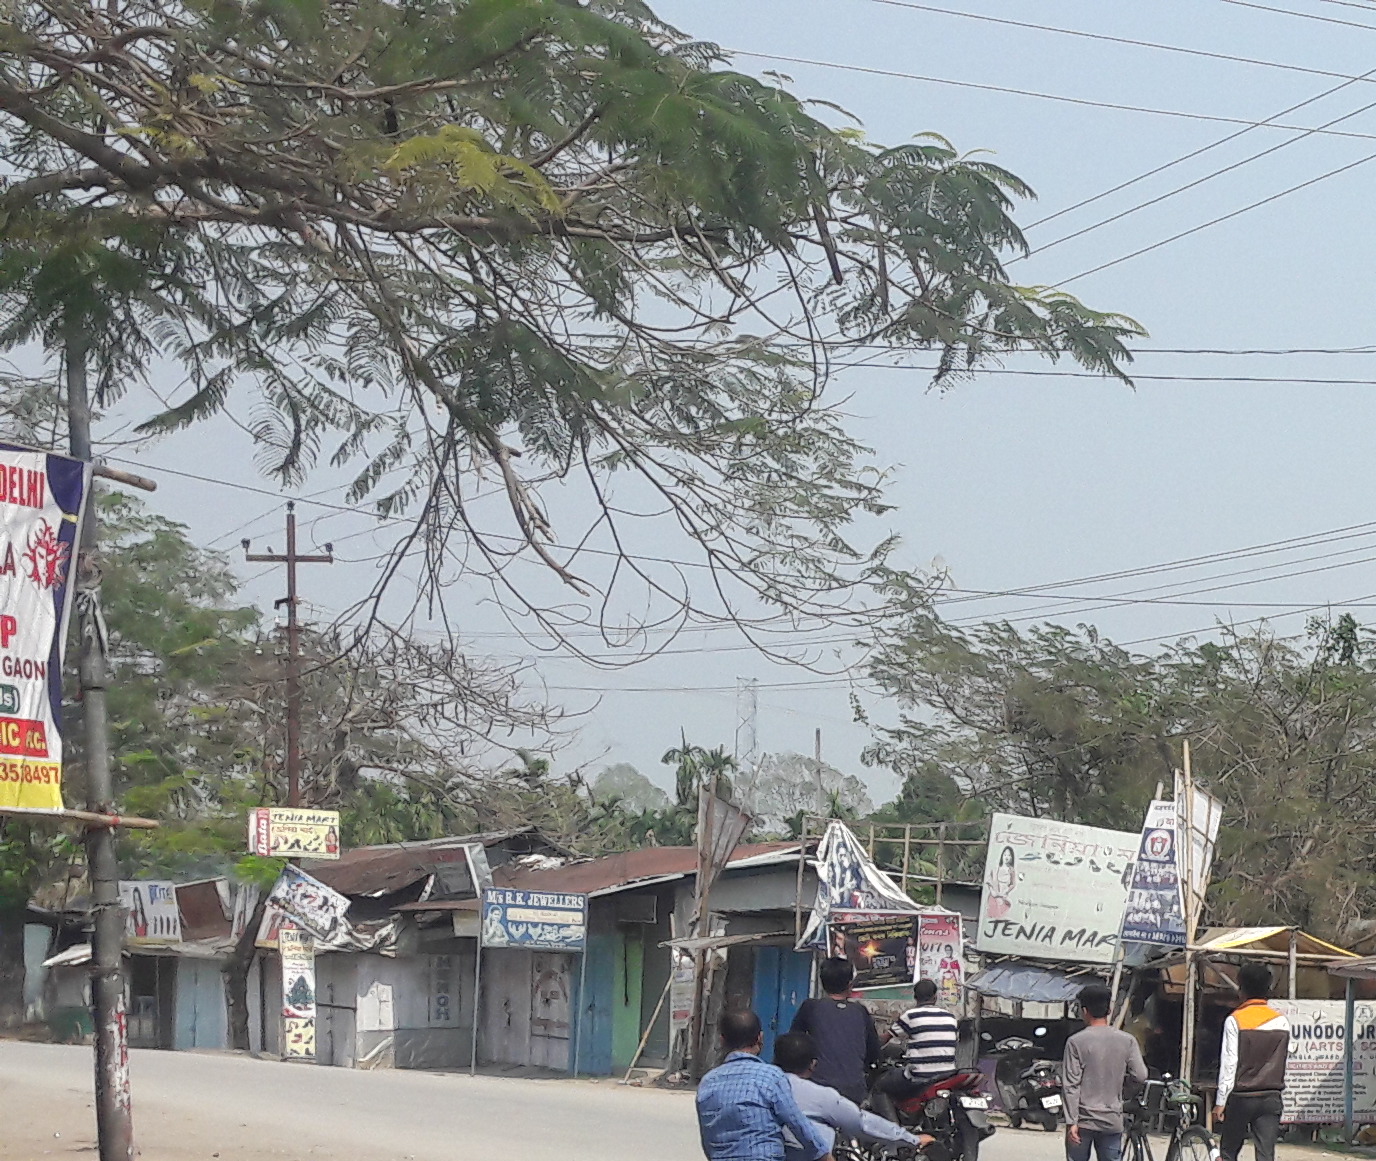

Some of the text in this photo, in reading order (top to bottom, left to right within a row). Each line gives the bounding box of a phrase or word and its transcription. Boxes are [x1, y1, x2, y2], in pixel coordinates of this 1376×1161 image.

[0, 541, 16, 578] A
[3, 656, 45, 680] GAON
[528, 894, 584, 909] JEWELLERS
[984, 920, 1056, 944] JENIA
[1291, 1025, 1344, 1040] UNODO
[1305, 1041, 1344, 1051] (ARTS
